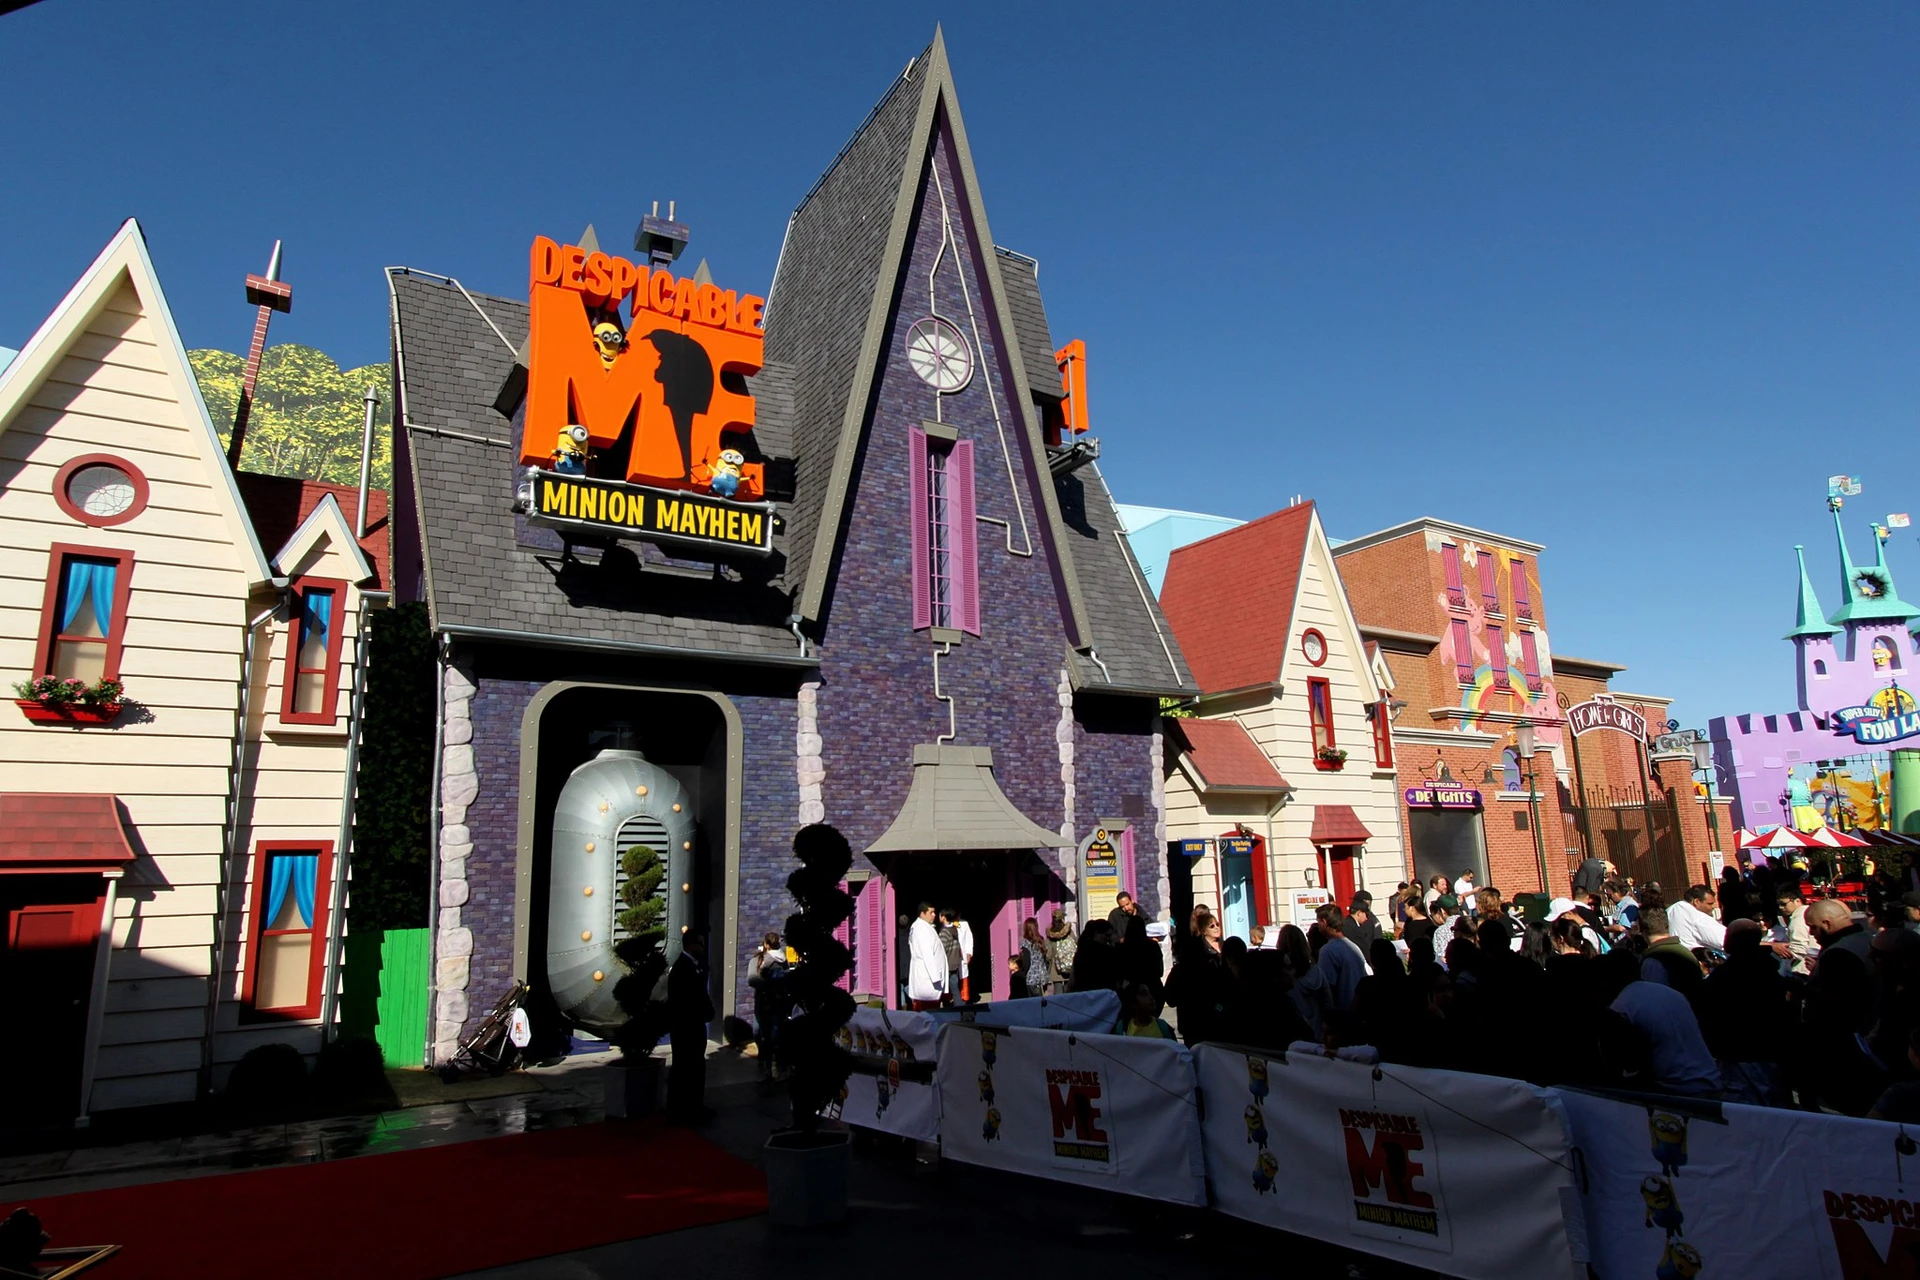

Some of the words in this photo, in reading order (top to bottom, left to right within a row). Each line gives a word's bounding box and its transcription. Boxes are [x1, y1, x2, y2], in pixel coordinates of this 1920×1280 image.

[530, 235, 764, 336] DESPICABLE
[520, 284, 764, 500] ME
[542, 480, 644, 526] MINION
[656, 499, 762, 545] MAYHEM
[1573, 706, 1606, 731] HOME
[1613, 708, 1642, 735] GIRLS
[1840, 707, 1864, 721] SUPER
[1860, 719, 1897, 740] FUN
[1046, 1069, 1100, 1086] DESPICABLE
[1048, 1084, 1108, 1142] ME
[1339, 1108, 1421, 1133] DESPICABLE
[1056, 1143, 1079, 1156] MINION
[1078, 1146, 1108, 1160] MAYHEM
[1344, 1127, 1436, 1209] ME
[1358, 1203, 1392, 1223] MINION
[1393, 1208, 1436, 1231] MAYHEM
